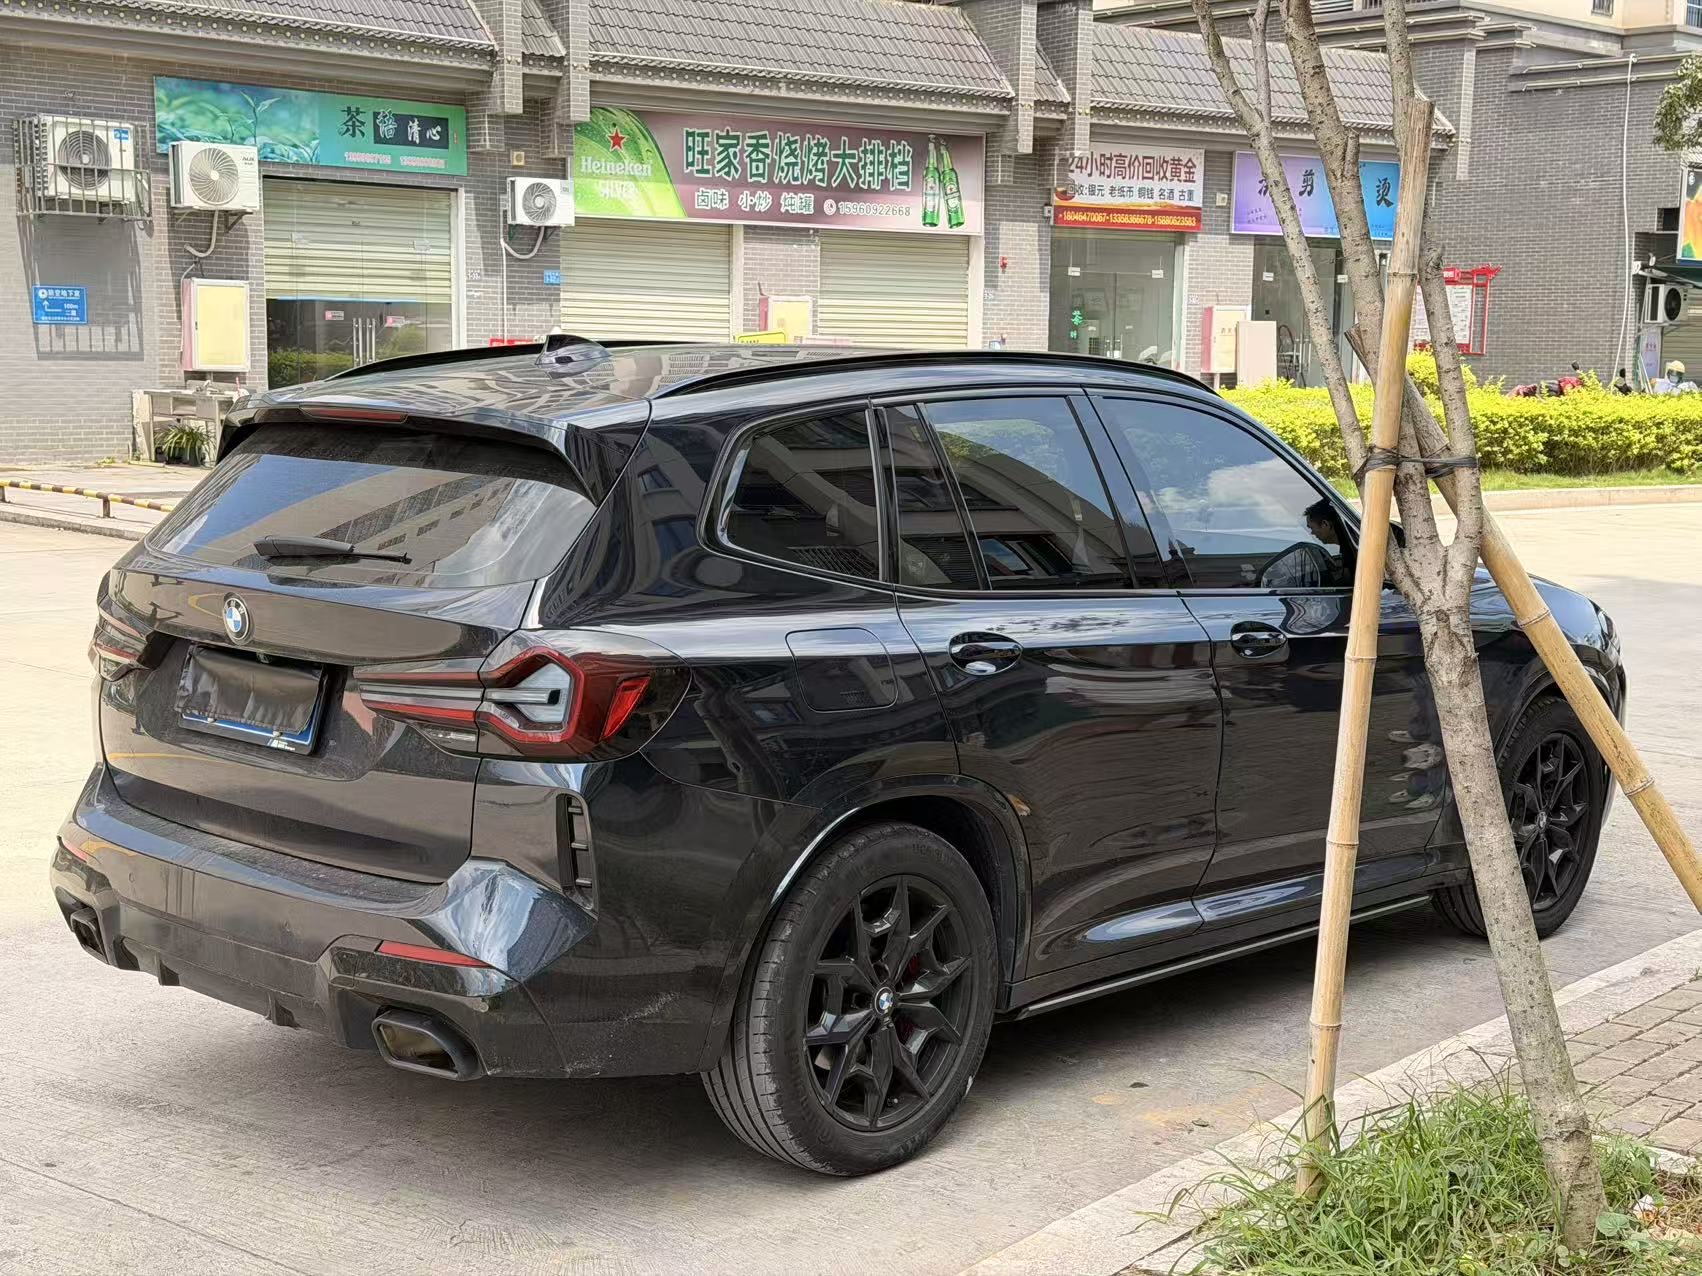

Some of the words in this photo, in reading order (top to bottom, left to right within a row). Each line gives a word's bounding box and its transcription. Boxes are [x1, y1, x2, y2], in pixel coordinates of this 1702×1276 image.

[581, 156, 652, 176] Heineken
[684, 127, 912, 190] 旺家香烧烤大排档
[695, 188, 729, 210] 卤味
[738, 190, 772, 212] 小炒
[781, 191, 814, 214] 炖罐
[1299, 169, 1315, 197] 剪
[1376, 177, 1394, 208] 烫
[838, 202, 911, 216] 15960922668
